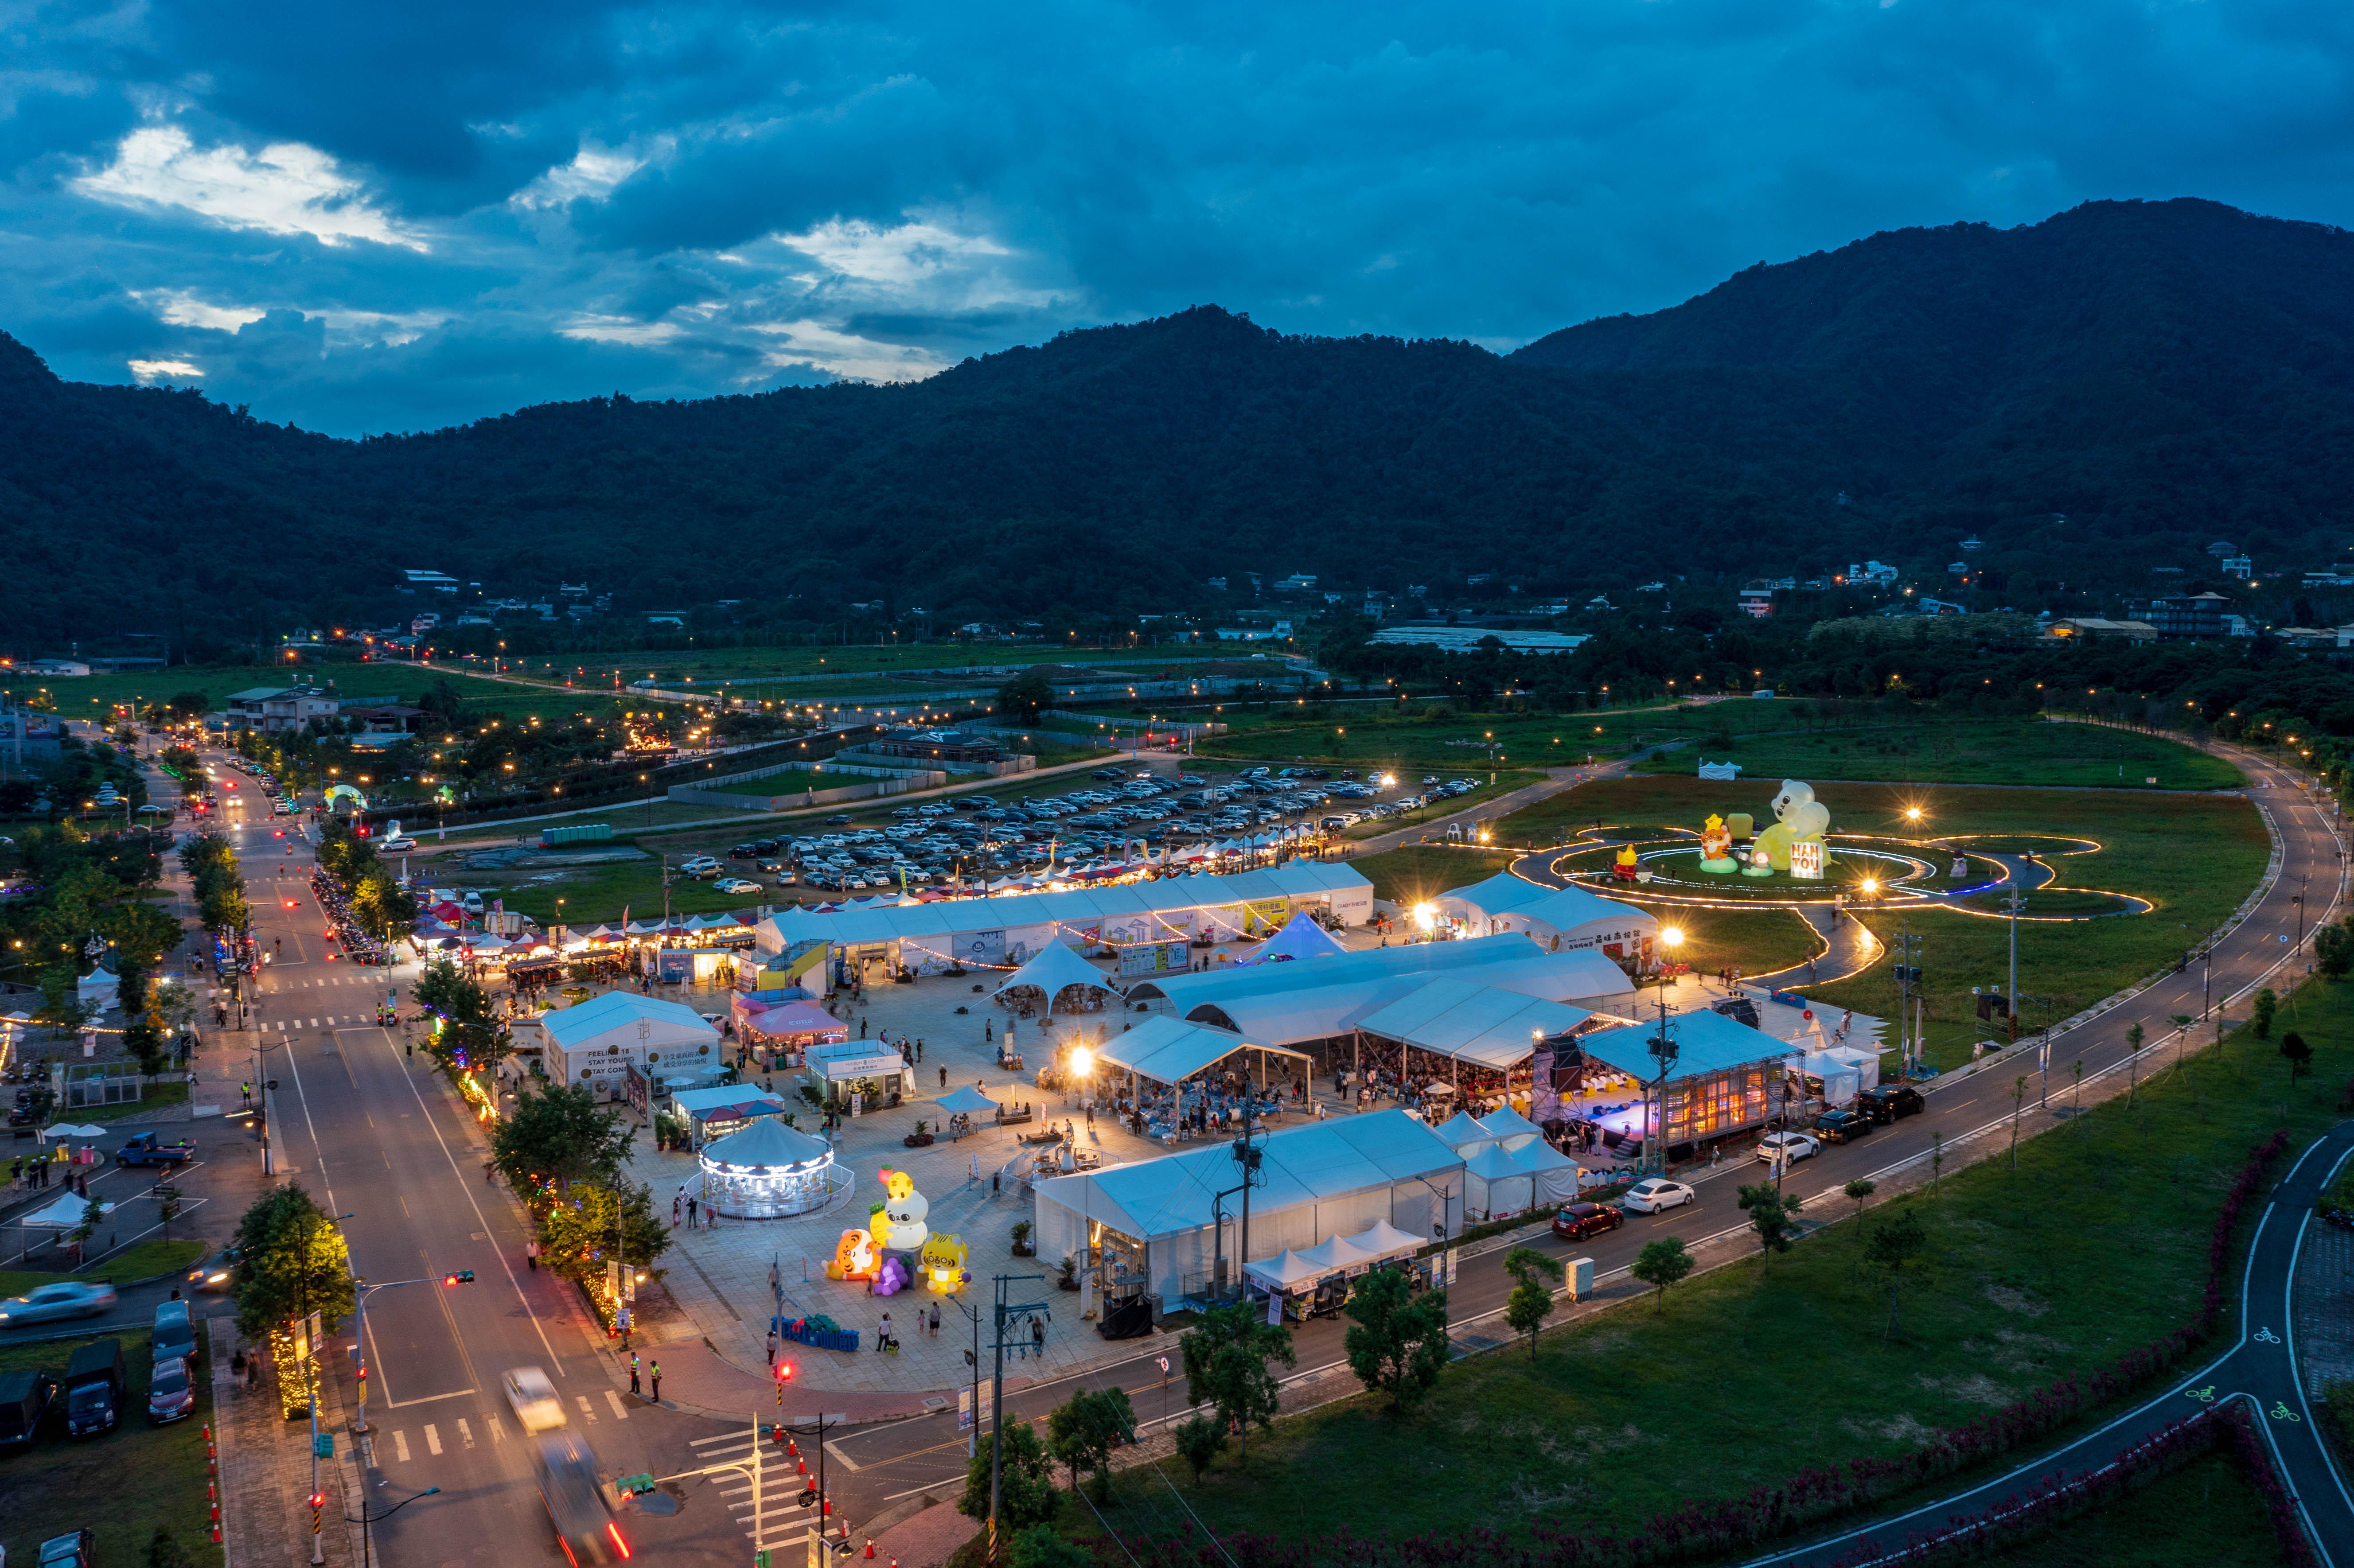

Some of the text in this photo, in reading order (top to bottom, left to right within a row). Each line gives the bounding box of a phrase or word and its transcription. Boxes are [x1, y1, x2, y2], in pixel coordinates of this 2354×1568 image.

[1792, 844, 1818, 858] NAN
[1792, 858, 1819, 871] TOU
[663, 1050, 706, 1060] 享受童真的美
[608, 1064, 654, 1074] CONTED
